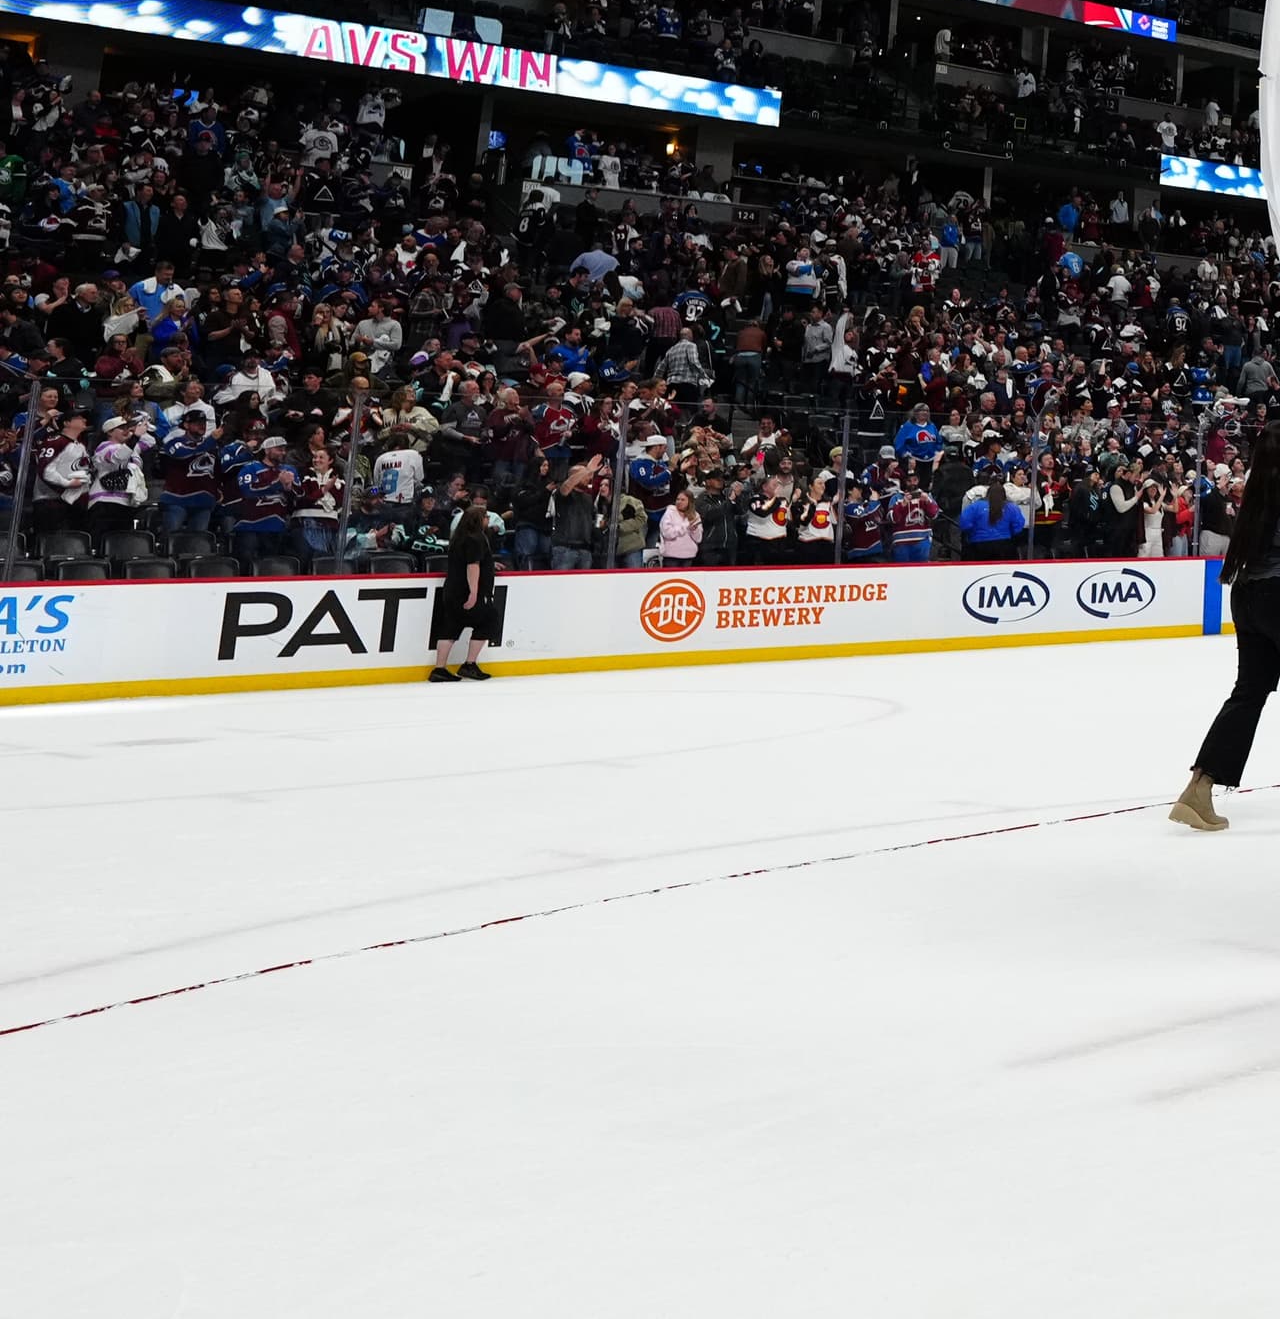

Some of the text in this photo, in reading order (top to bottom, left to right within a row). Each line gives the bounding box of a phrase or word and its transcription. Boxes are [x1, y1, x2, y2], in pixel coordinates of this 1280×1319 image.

[303, 24, 552, 88] AVS WIN
[383, 469, 399, 494] 8
[717, 583, 887, 607] BRECKENRIDGE
[978, 584, 1036, 609] IMA
[1090, 581, 1142, 605] IMA
[716, 605, 824, 630] BREWERY
